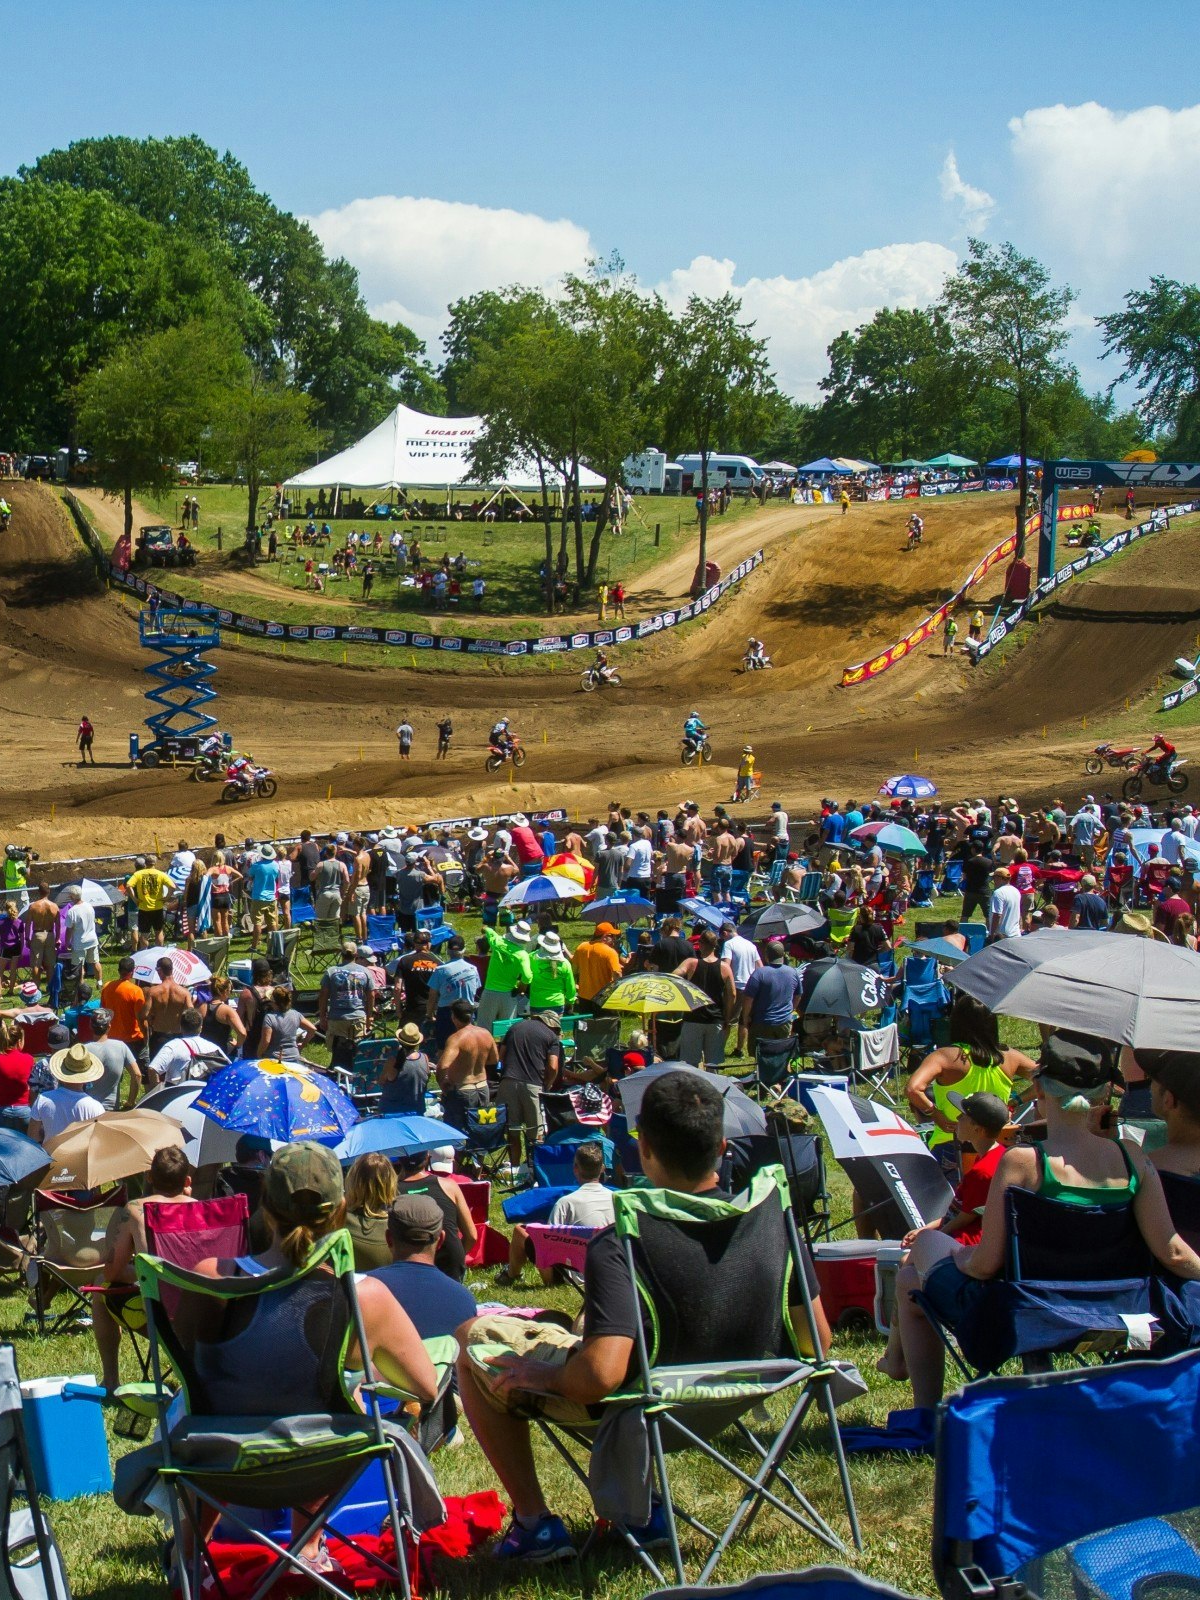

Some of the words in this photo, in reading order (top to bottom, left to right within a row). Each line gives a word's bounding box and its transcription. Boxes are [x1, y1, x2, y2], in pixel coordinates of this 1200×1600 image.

[1055, 467, 1092, 479] WPS
[1104, 463, 1200, 481] FLY
[622, 981, 671, 998] MOTO
[628, 989, 675, 1005] TEES
